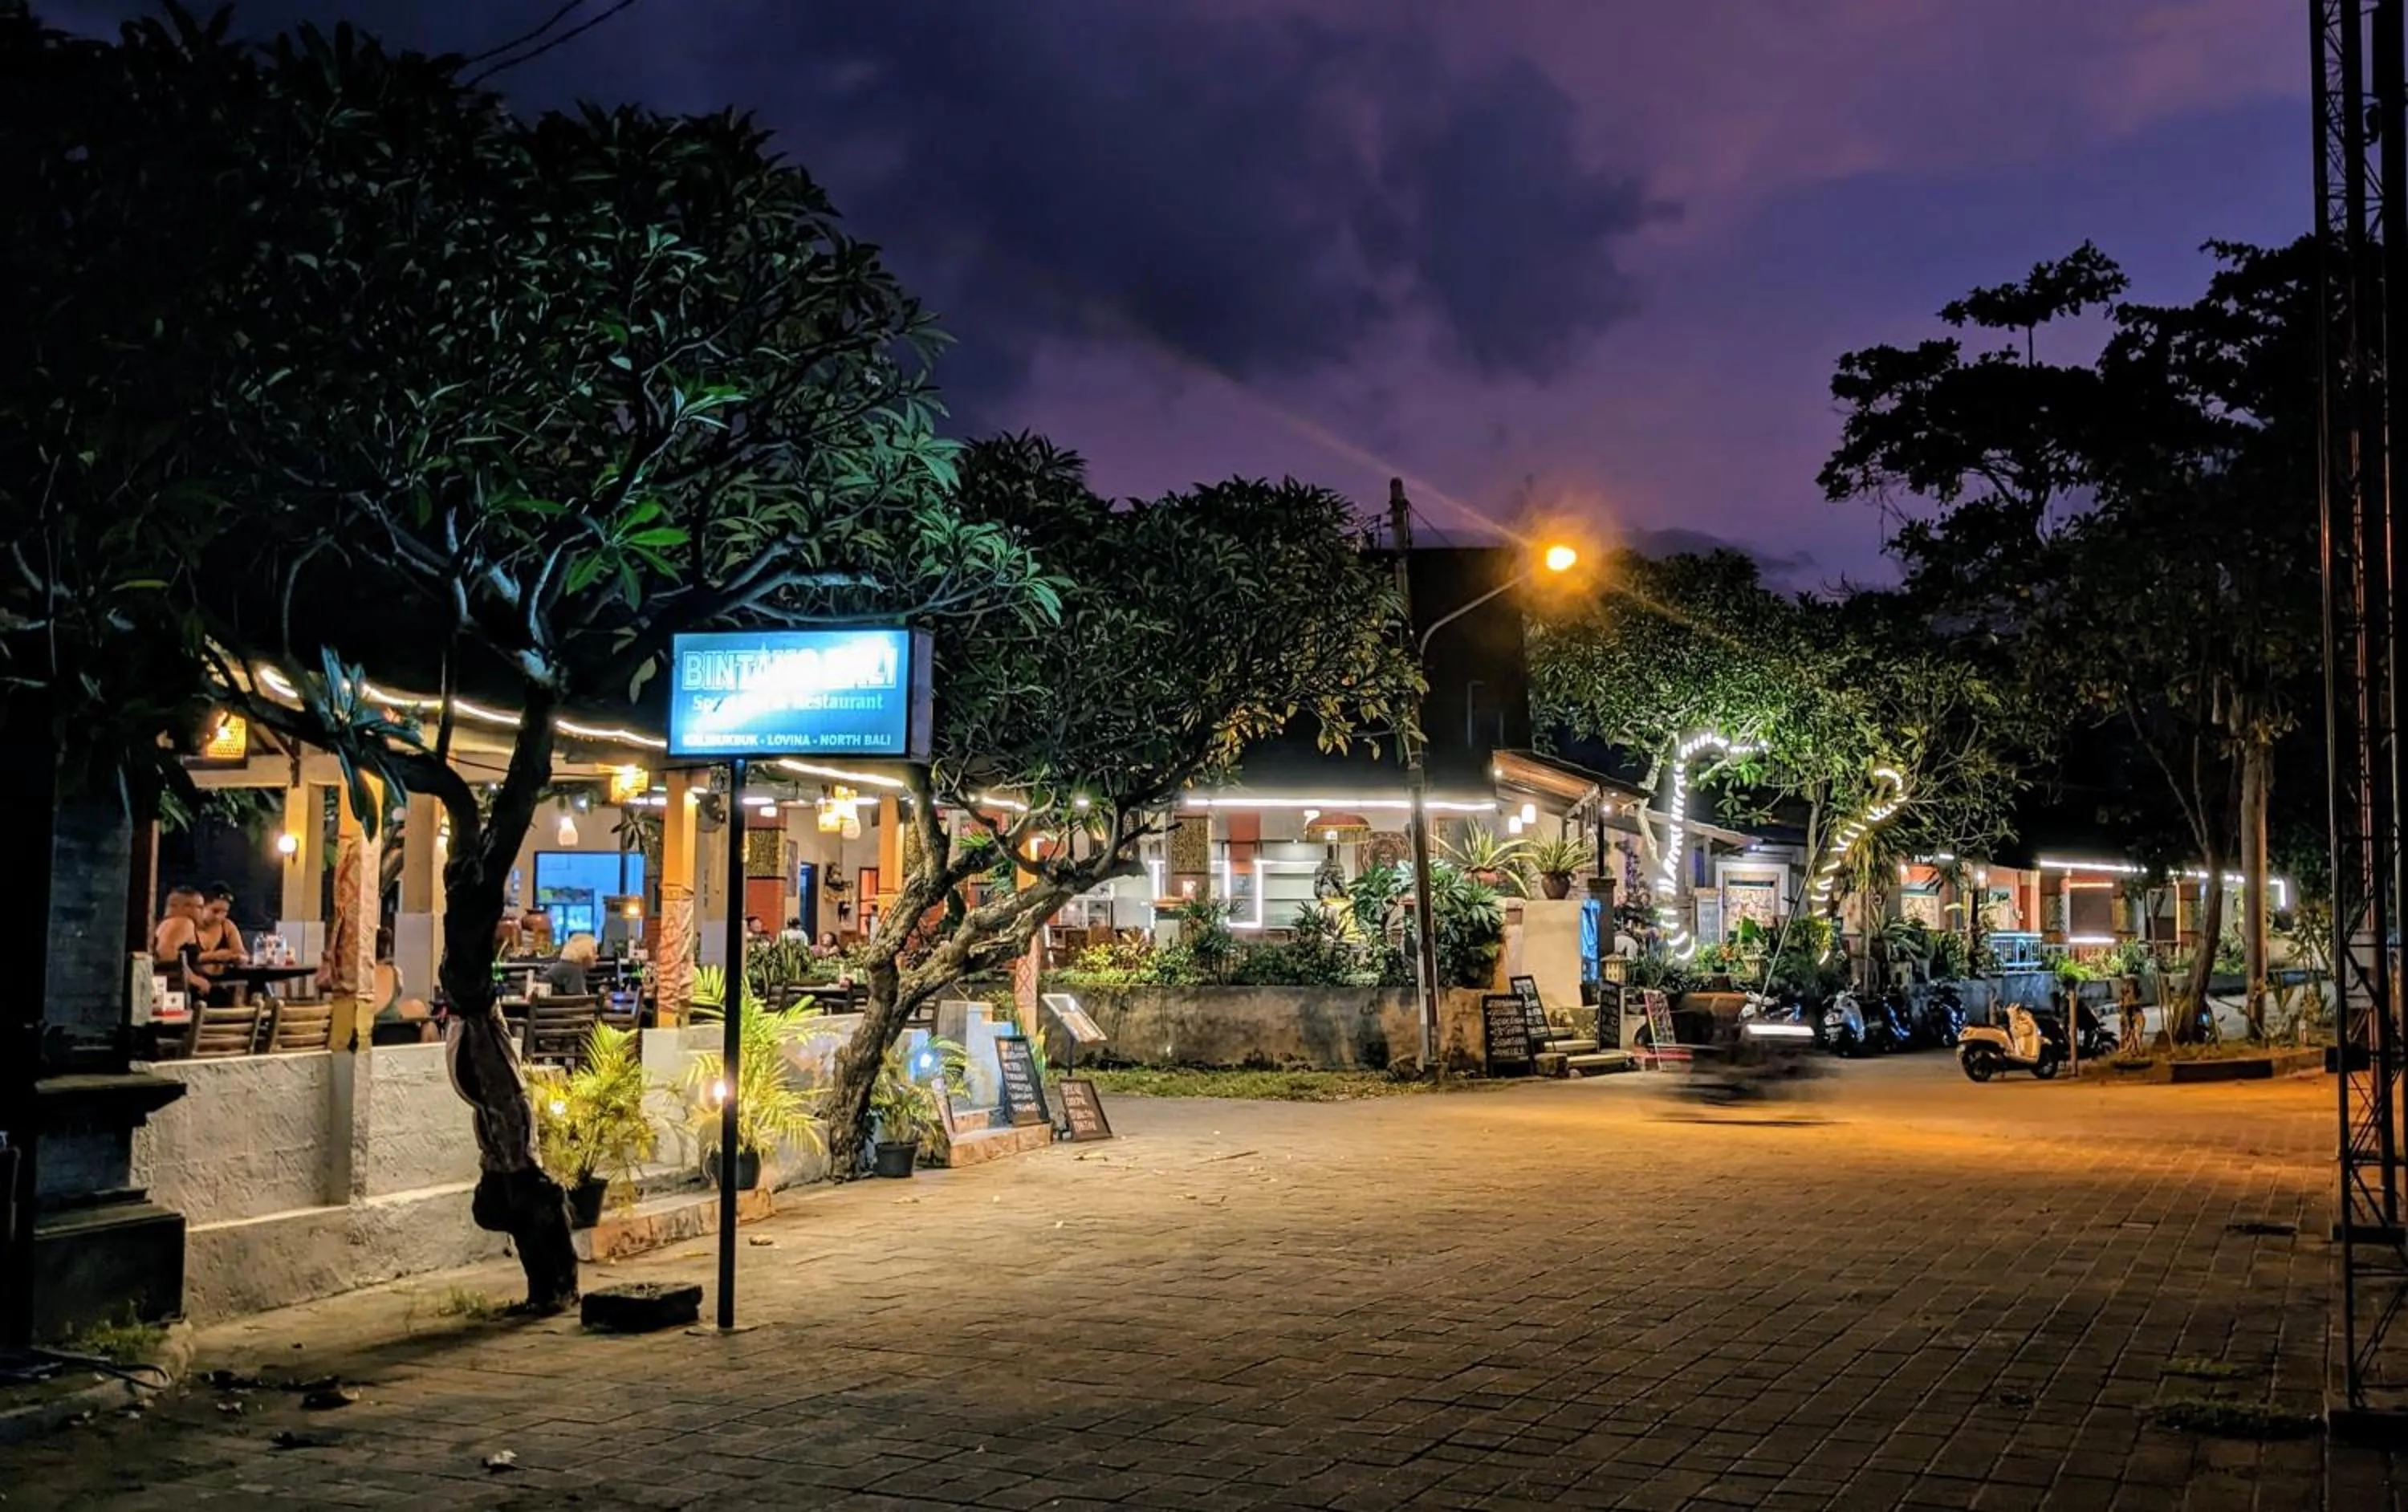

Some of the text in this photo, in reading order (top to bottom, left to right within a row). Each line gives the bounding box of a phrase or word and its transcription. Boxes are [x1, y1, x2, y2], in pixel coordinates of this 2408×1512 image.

[681, 647, 819, 692] BINTA
[767, 734, 811, 746] LOVINA
[820, 734, 861, 746] NORTH
[864, 734, 892, 746] BALI
